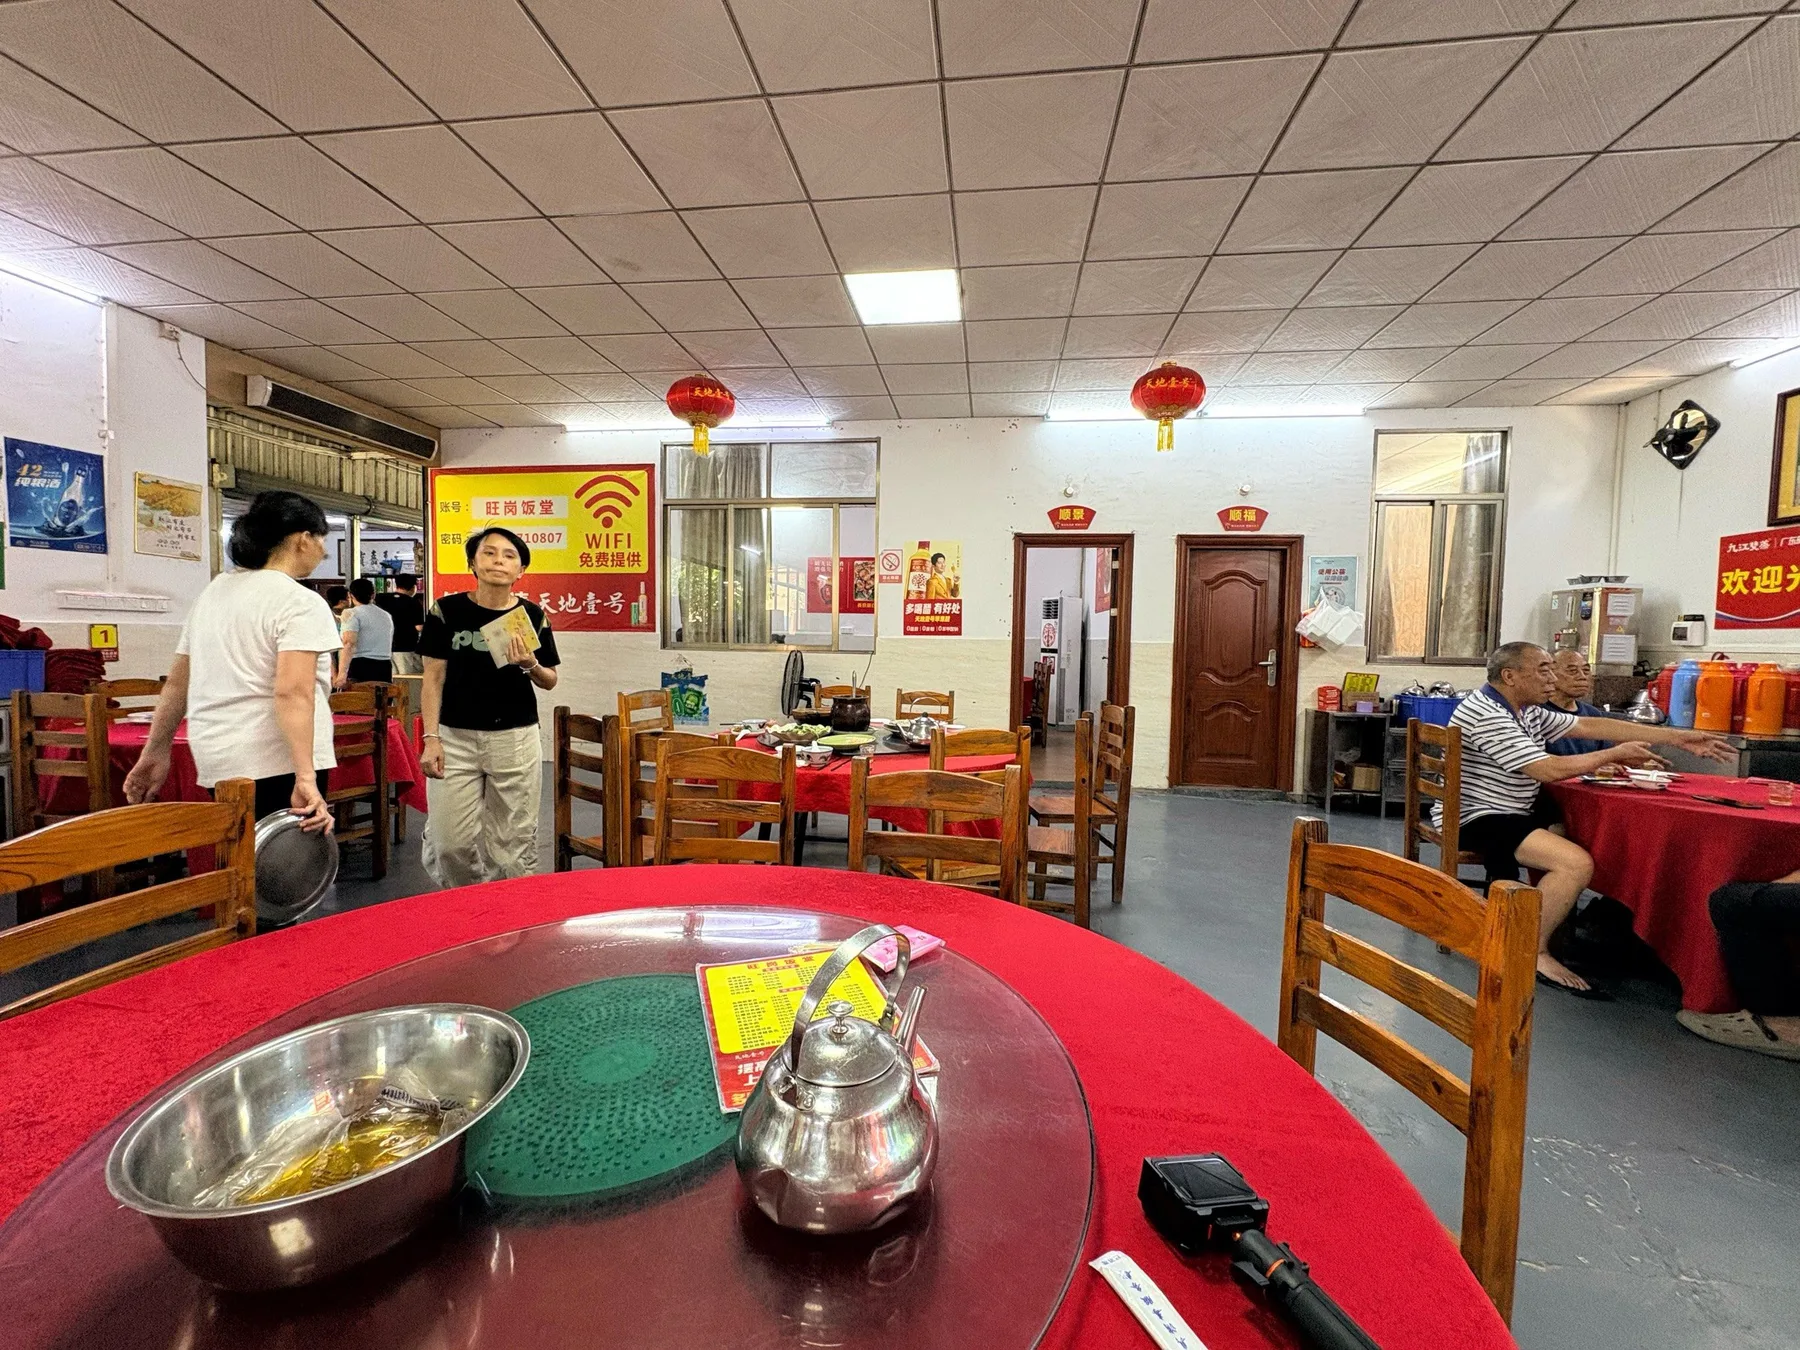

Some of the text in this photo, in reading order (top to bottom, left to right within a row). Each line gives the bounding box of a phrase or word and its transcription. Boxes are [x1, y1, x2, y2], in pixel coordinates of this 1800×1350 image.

[485, 500, 555, 516] 旺岗饭堂
[1229, 509, 1257, 522] 顺福
[585, 532, 632, 549] WIFI
[579, 551, 642, 568] 免费提供
[539, 591, 627, 616] 天地壹号
[905, 602, 961, 615] 多喝醋 有好处
[100, 629, 109, 644] 1
